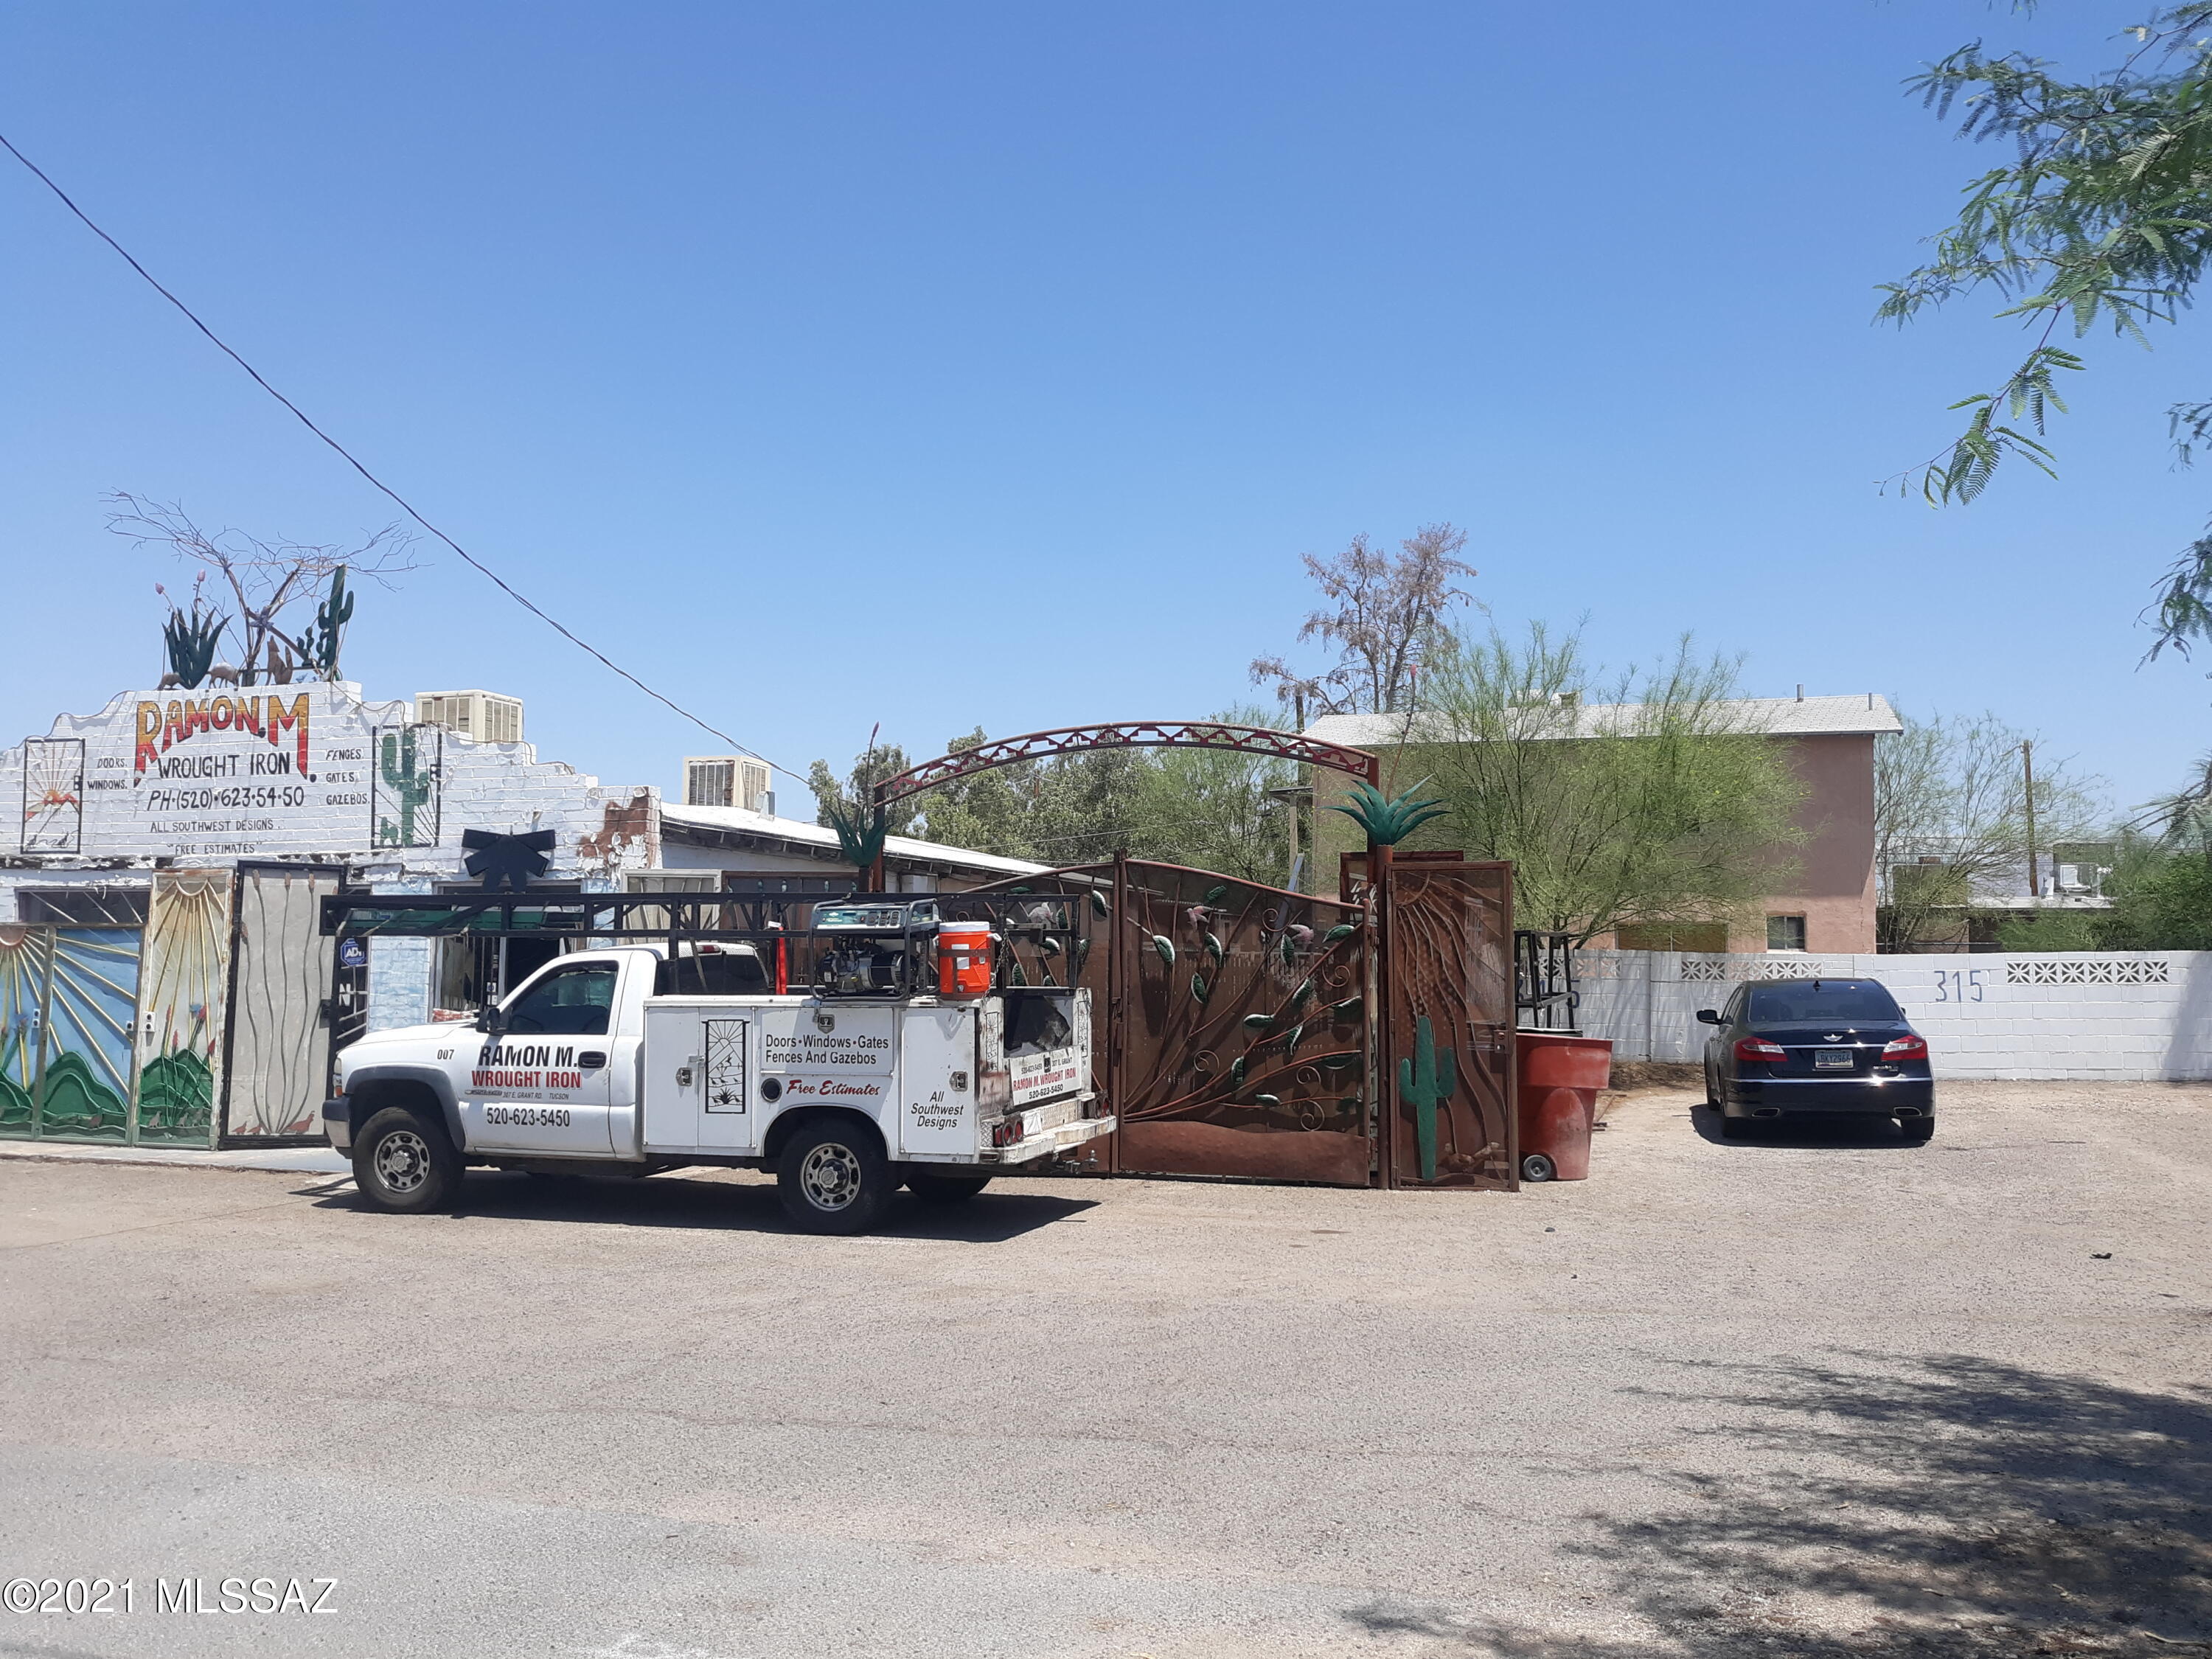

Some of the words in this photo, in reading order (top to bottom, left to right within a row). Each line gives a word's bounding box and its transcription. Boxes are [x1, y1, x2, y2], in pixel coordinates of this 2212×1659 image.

[158, 754, 240, 779] WROUGHT
[250, 752, 290, 775] IRON
[87, 779, 128, 790] WINDOWS.
[326, 793, 370, 805] GAZEBOS.
[150, 822, 170, 832] ALL
[172, 821, 231, 832] SOUTHWEST
[1934, 970, 1983, 1003] 315
[766, 1034, 796, 1048] Doors
[803, 1034, 851, 1048] Windows
[858, 1035, 889, 1048] Gates
[437, 1049, 454, 1060] 007
[478, 1046, 550, 1067] RAMON
[554, 1046, 578, 1068] M.
[765, 1050, 803, 1063] Fences
[805, 1051, 827, 1063] And
[830, 1051, 877, 1065] Gazebos
[472, 1071, 540, 1088] WROUGHT
[546, 1071, 581, 1088] IRON
[1013, 1077, 1032, 1091] RAMON
[1034, 1076, 1040, 1087] M.
[1040, 1070, 1063, 1085] WROUGHT
[1065, 1067, 1077, 1079] IRON
[786, 1079, 816, 1094] Free
[818, 1080, 881, 1096] Estimates
[1029, 1084, 1064, 1099] 520-623-5450
[929, 1091, 945, 1102] All
[911, 1102, 964, 1116] Southwest
[487, 1107, 571, 1127] 520-623-5450
[917, 1115, 958, 1130] Designs
